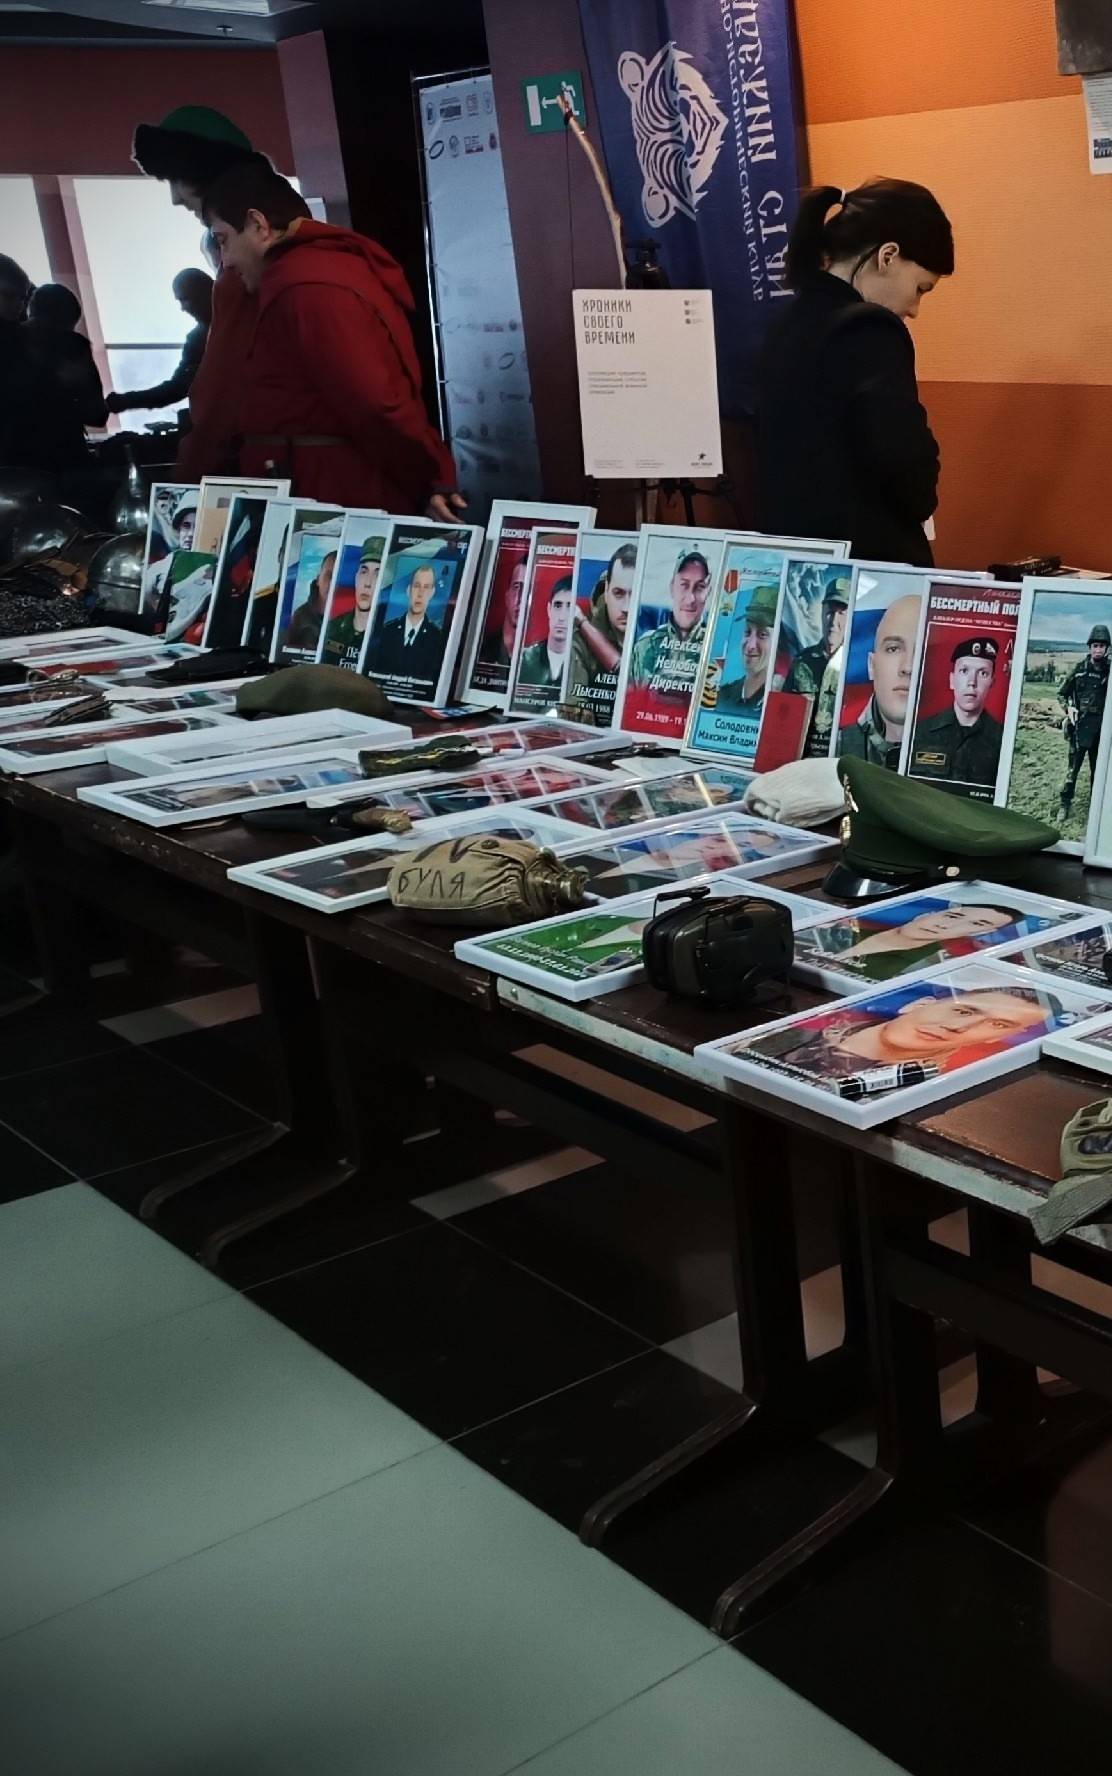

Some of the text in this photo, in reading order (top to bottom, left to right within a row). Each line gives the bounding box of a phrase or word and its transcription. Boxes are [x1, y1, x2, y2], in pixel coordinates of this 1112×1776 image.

[583, 299, 632, 312] ХРОНИКИ
[584, 315, 623, 328] СВОЕГО
[585, 331, 635, 344] ВРЕМЕНИ
[930, 597, 1000, 614] БЕССМЕРТНЫЙ
[398, 866, 466, 901] БУЛЯ
